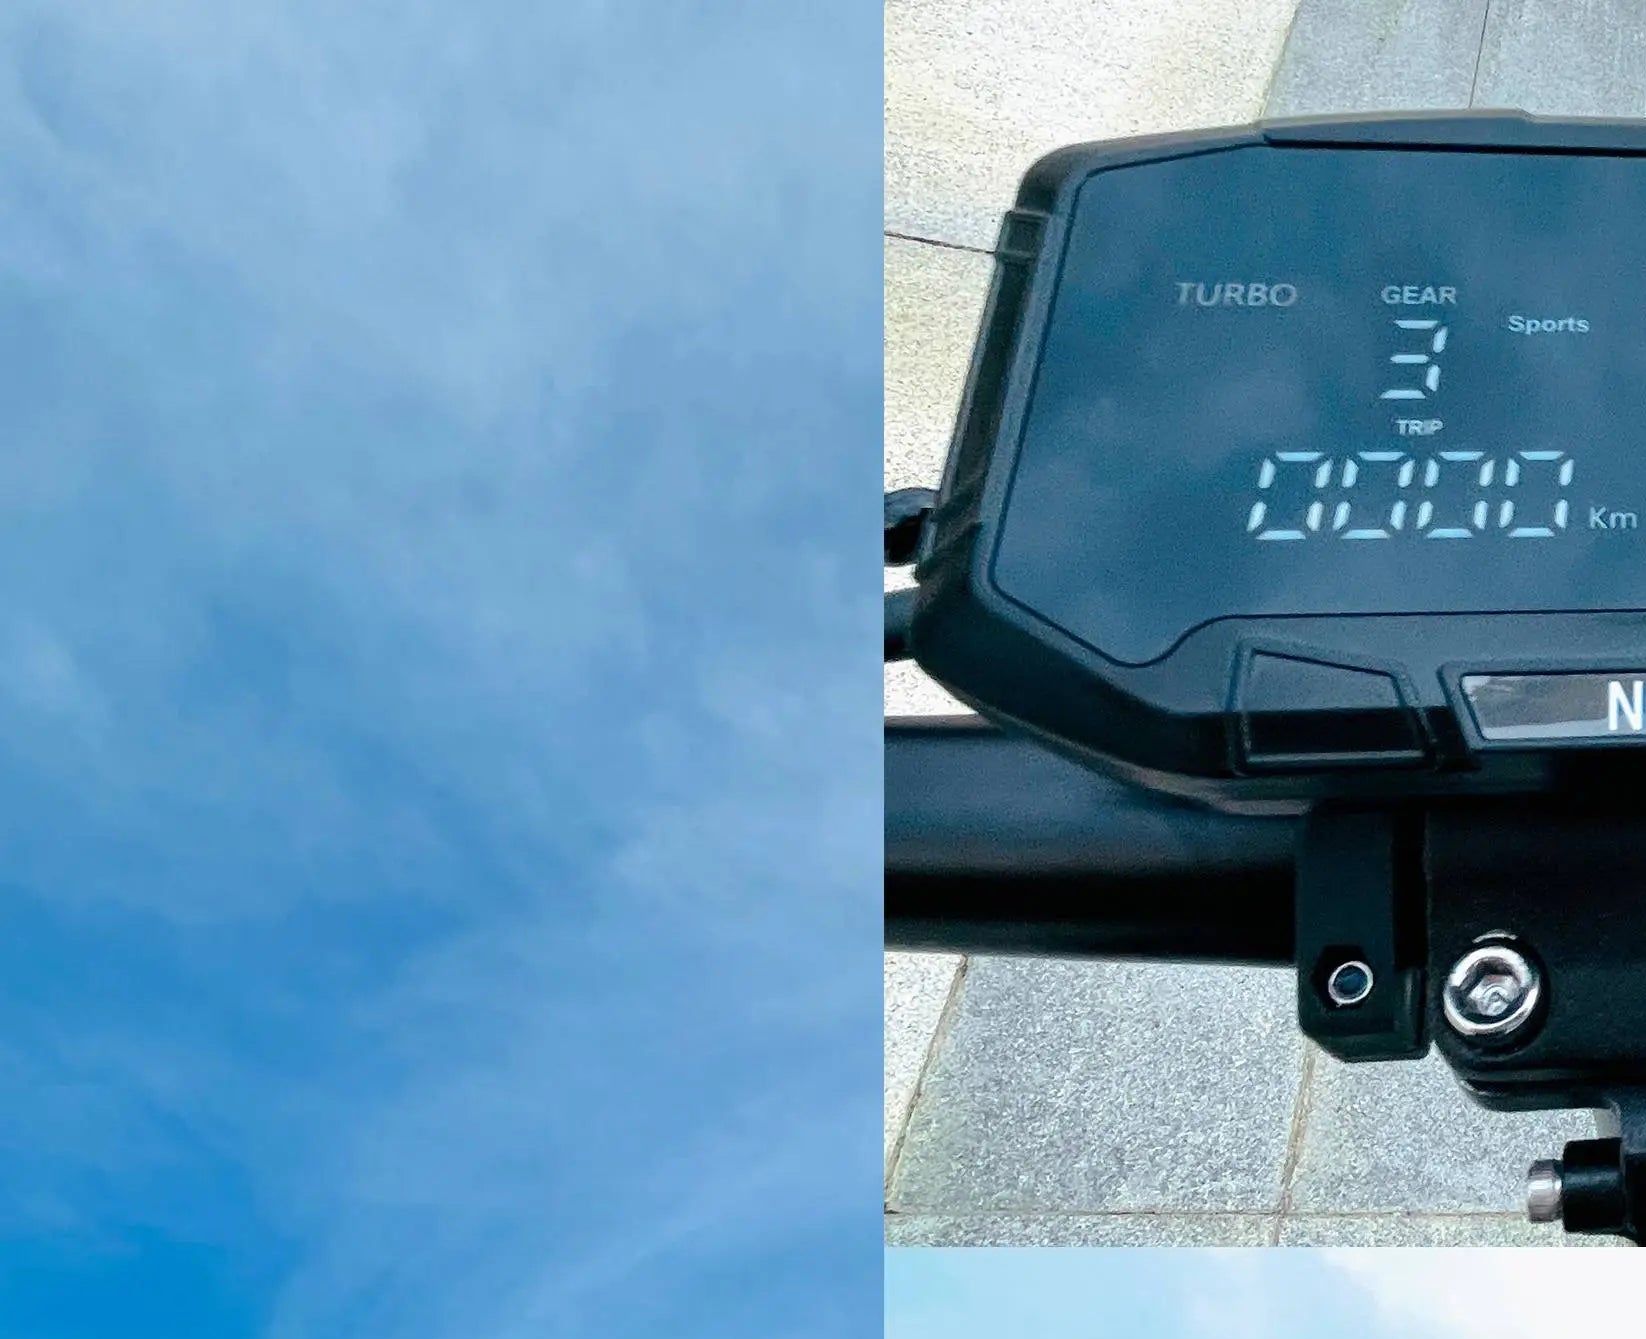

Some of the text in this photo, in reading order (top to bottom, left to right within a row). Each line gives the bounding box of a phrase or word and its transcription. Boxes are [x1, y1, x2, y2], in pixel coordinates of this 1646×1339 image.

[1174, 282, 1298, 307] TURBO
[1380, 285, 1457, 305] GEAR
[1507, 315, 1590, 335] Sports
[1379, 319, 1449, 400] 3
[1395, 417, 1444, 437] TRIP
[1246, 450, 1639, 541] 0000 Km
